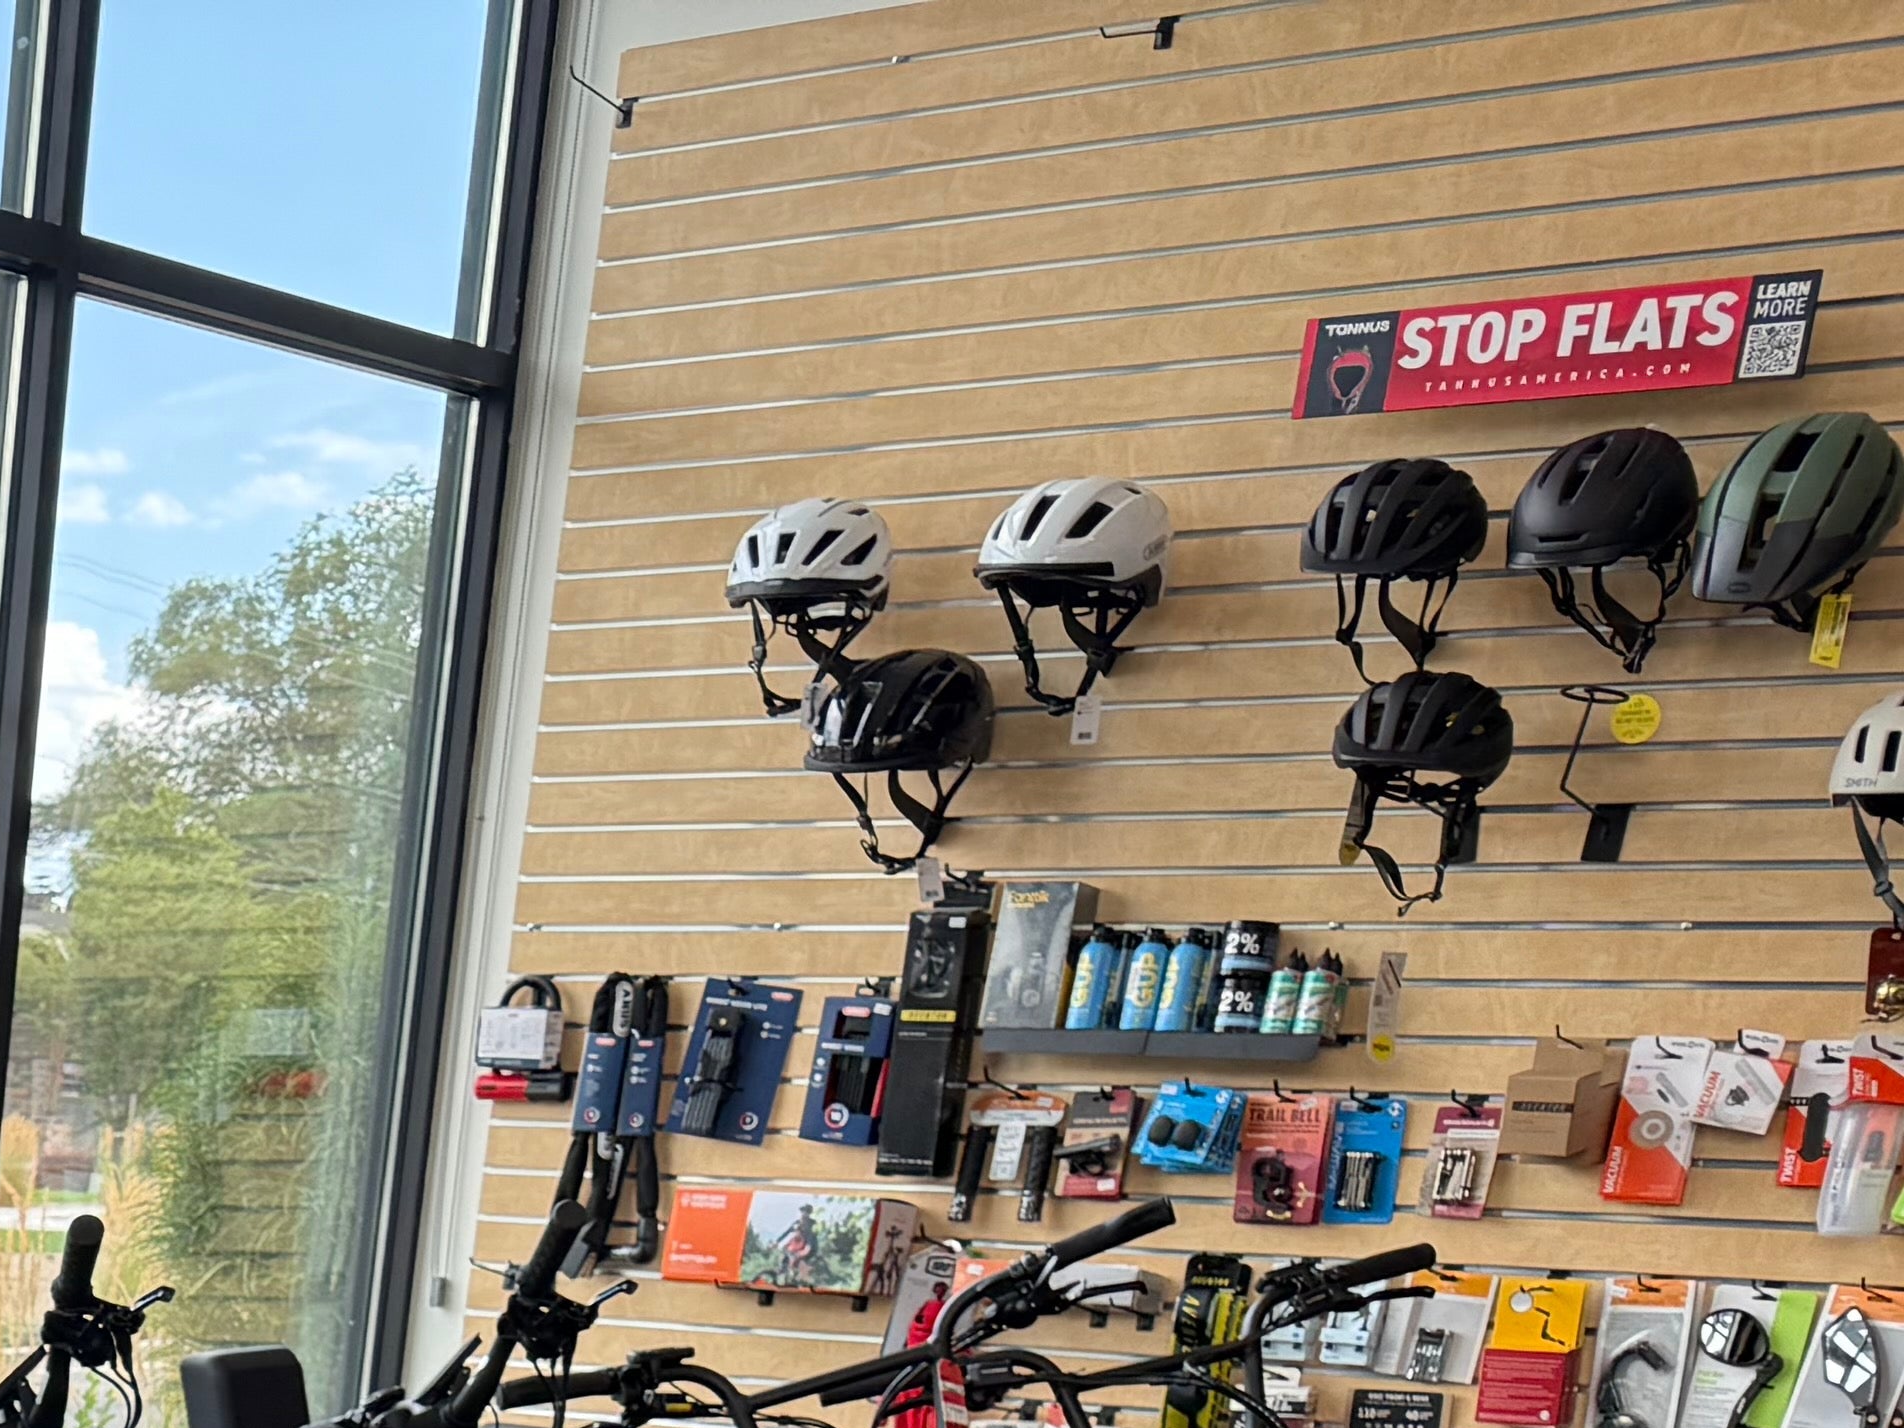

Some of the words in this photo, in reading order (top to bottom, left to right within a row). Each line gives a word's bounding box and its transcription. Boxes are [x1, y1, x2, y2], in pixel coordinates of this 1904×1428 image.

[1757, 280, 1812, 299] LEARN
[1753, 297, 1807, 318] MORE
[1397, 313, 1546, 370] STOP
[1558, 292, 1740, 357] FLATS
[1424, 361, 1693, 393] TANNUSAMERICA.COM
[1844, 777, 1878, 788] SMITH
[1224, 932, 1260, 955] 2%
[1219, 990, 1255, 1013] 2%
[1693, 1070, 1721, 1118] VACUUM
[1249, 1107, 1286, 1122] TRAIL
[1290, 1108, 1321, 1123] BELL
[1603, 1145, 1624, 1194] VACUUM
[1779, 1147, 1797, 1183] TWIST
